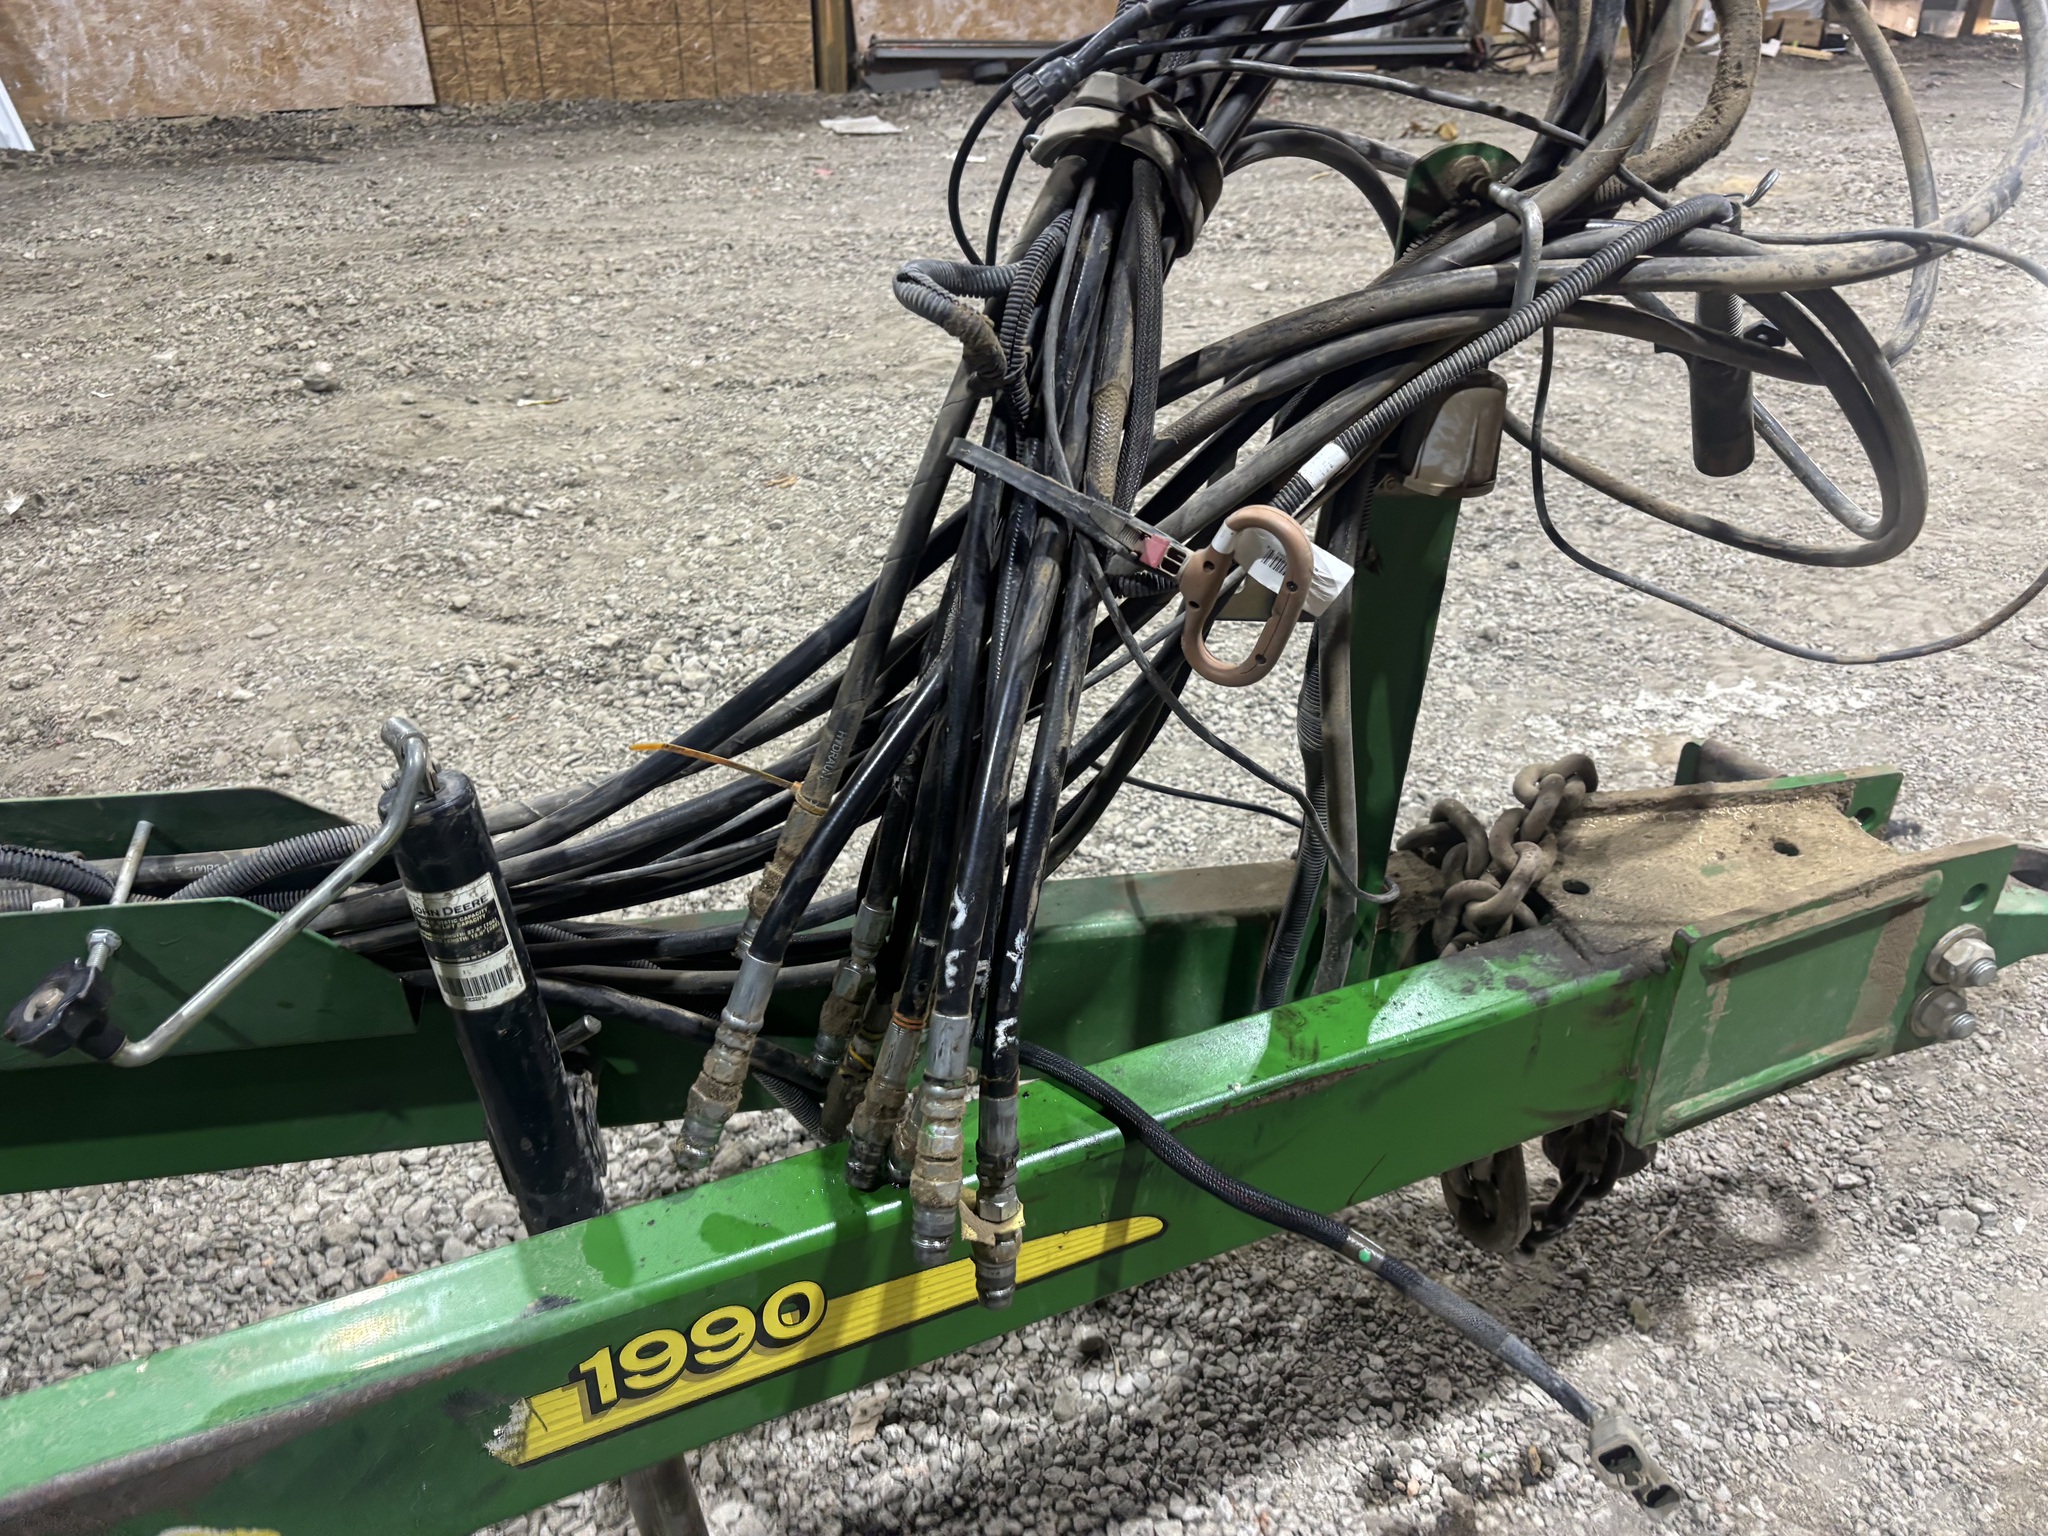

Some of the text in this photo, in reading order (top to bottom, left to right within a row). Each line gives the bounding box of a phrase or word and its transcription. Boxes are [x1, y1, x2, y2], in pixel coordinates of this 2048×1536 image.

[413, 896, 489, 916] JOHN DEERE
[459, 906, 489, 921] CAPACITY
[456, 913, 486, 928] CAPACITY
[570, 1280, 827, 1414] 1990
